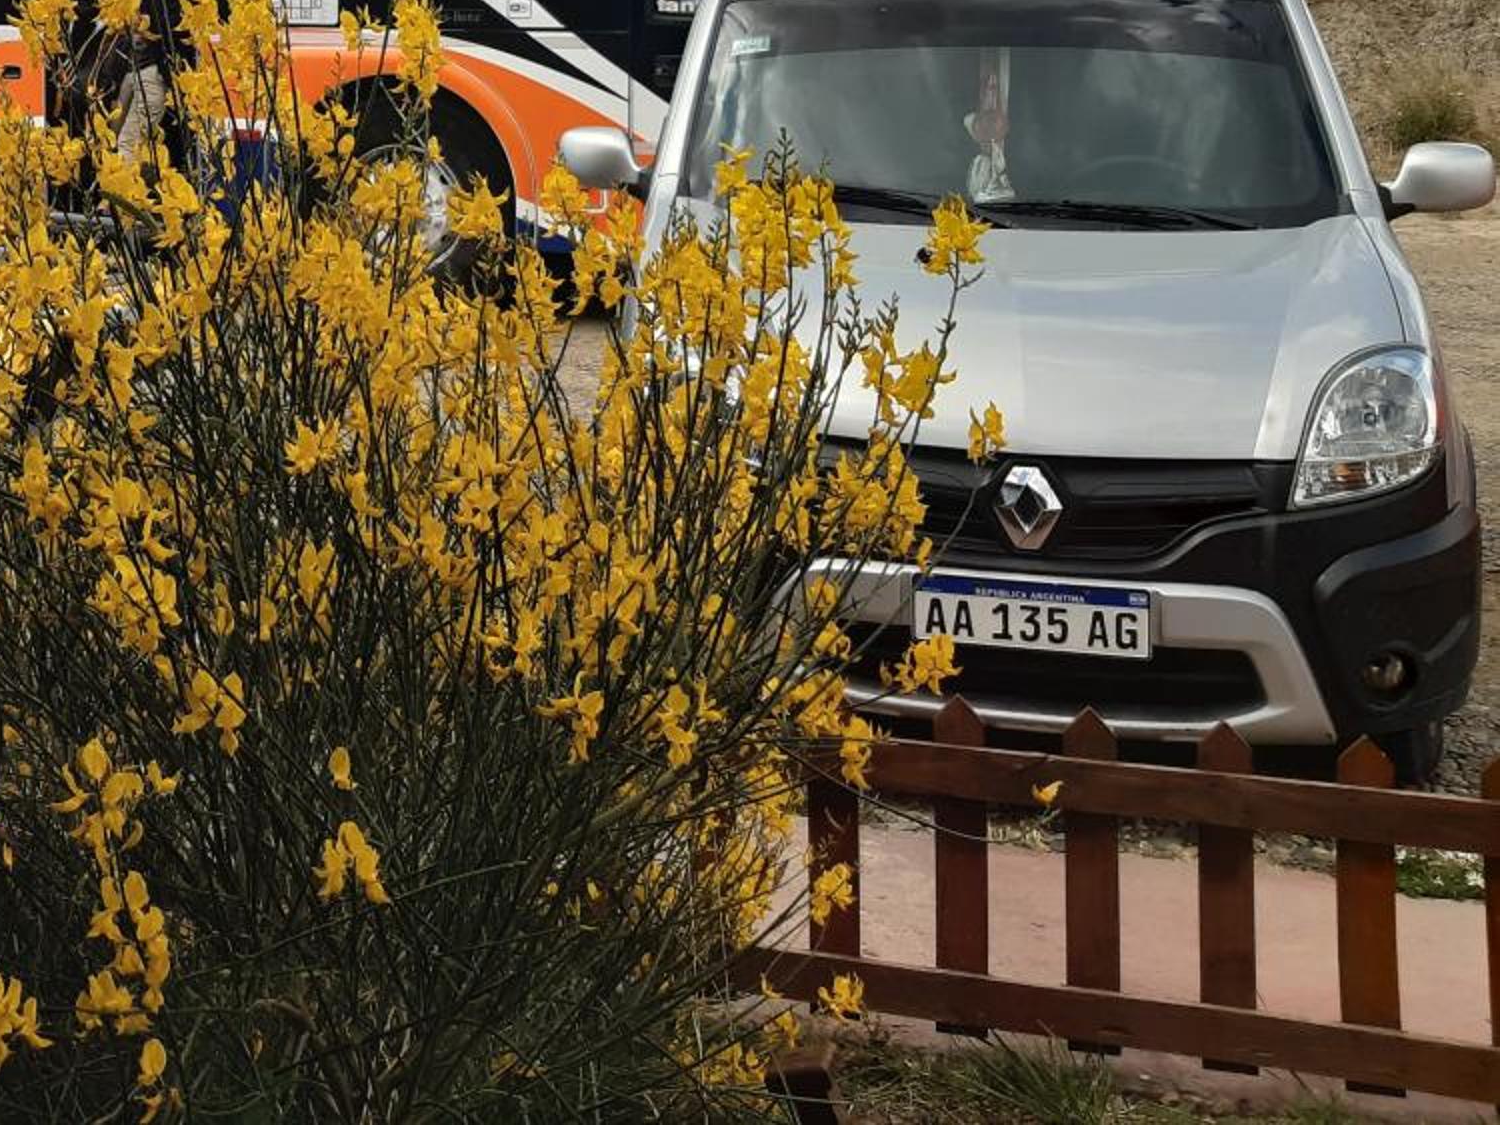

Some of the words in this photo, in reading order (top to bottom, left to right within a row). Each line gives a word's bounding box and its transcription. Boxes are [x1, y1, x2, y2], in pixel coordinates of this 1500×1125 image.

[925, 598, 975, 637] AA
[991, 603, 1069, 644] 135
[1087, 610, 1138, 650] AG
